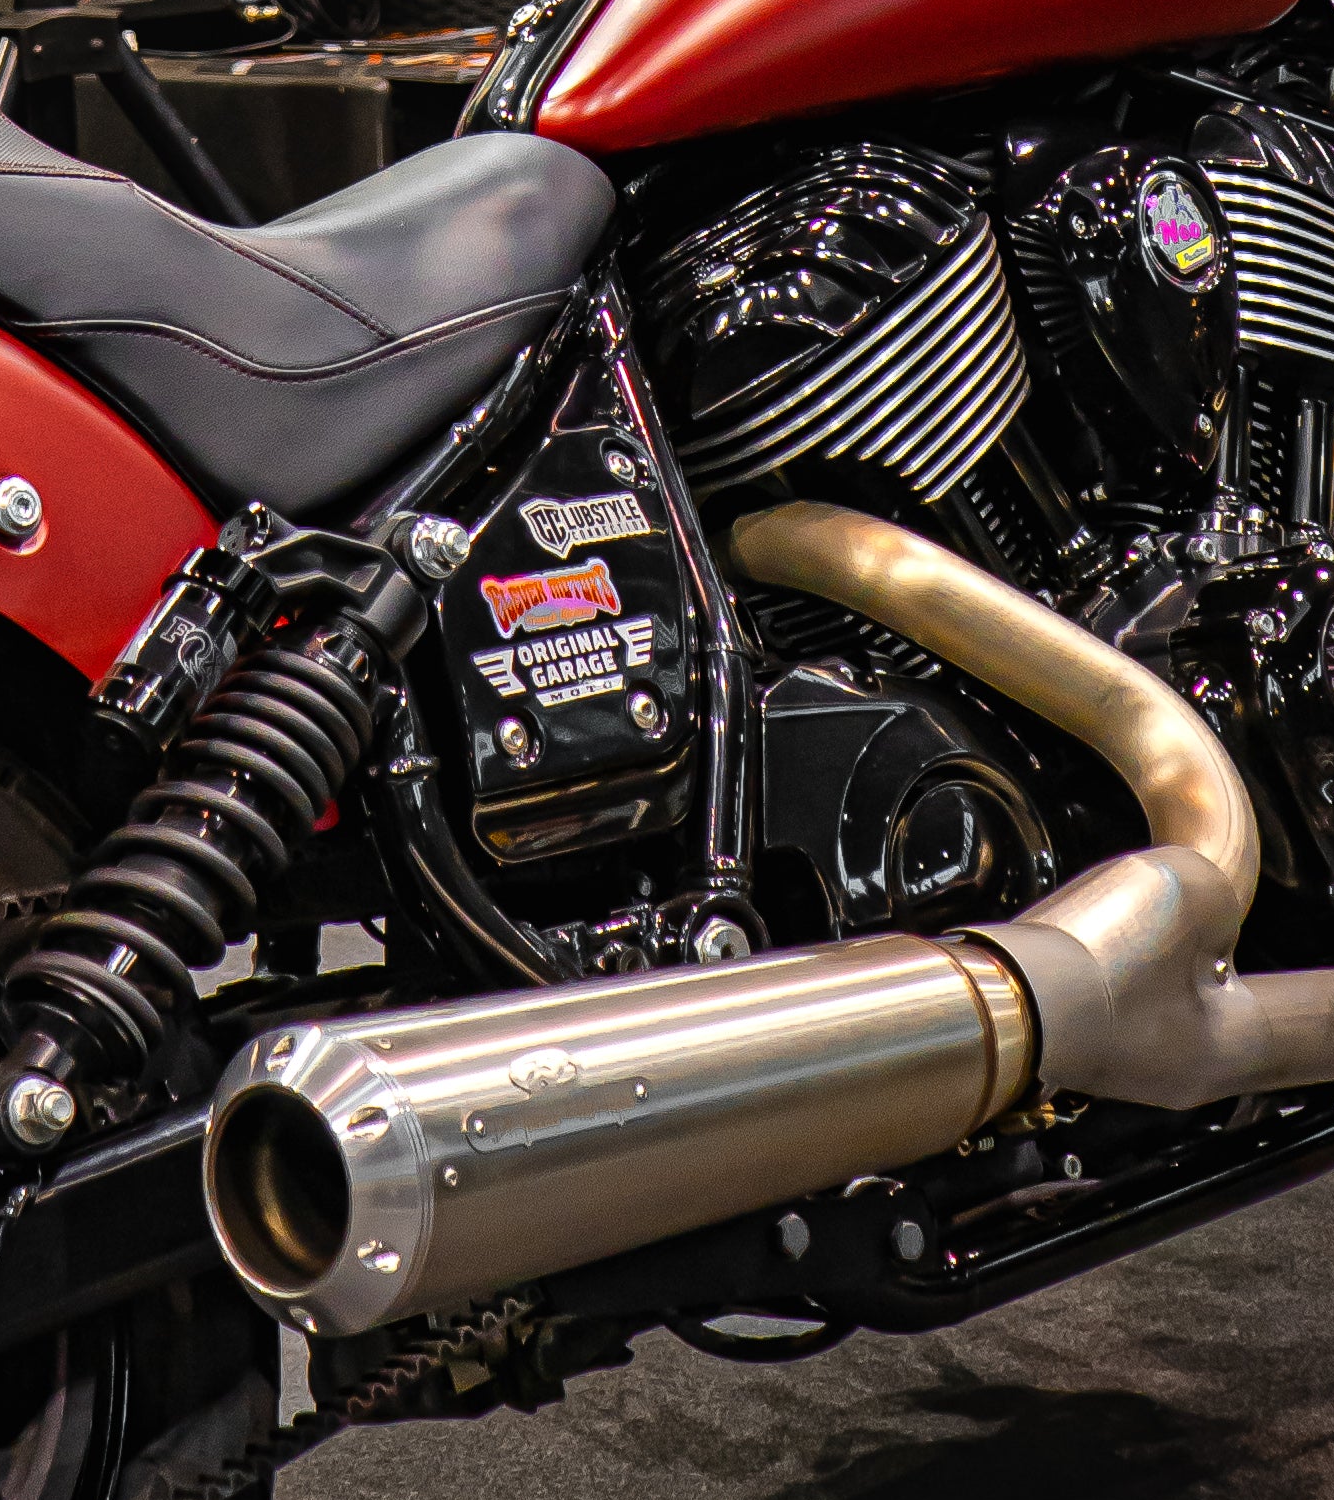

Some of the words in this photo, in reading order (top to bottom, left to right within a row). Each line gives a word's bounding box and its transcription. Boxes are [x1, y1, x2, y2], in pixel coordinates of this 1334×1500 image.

[517, 627, 620, 667] ORIGINAL
[531, 650, 619, 688] GARAGE
[549, 680, 614, 702] MOTO
